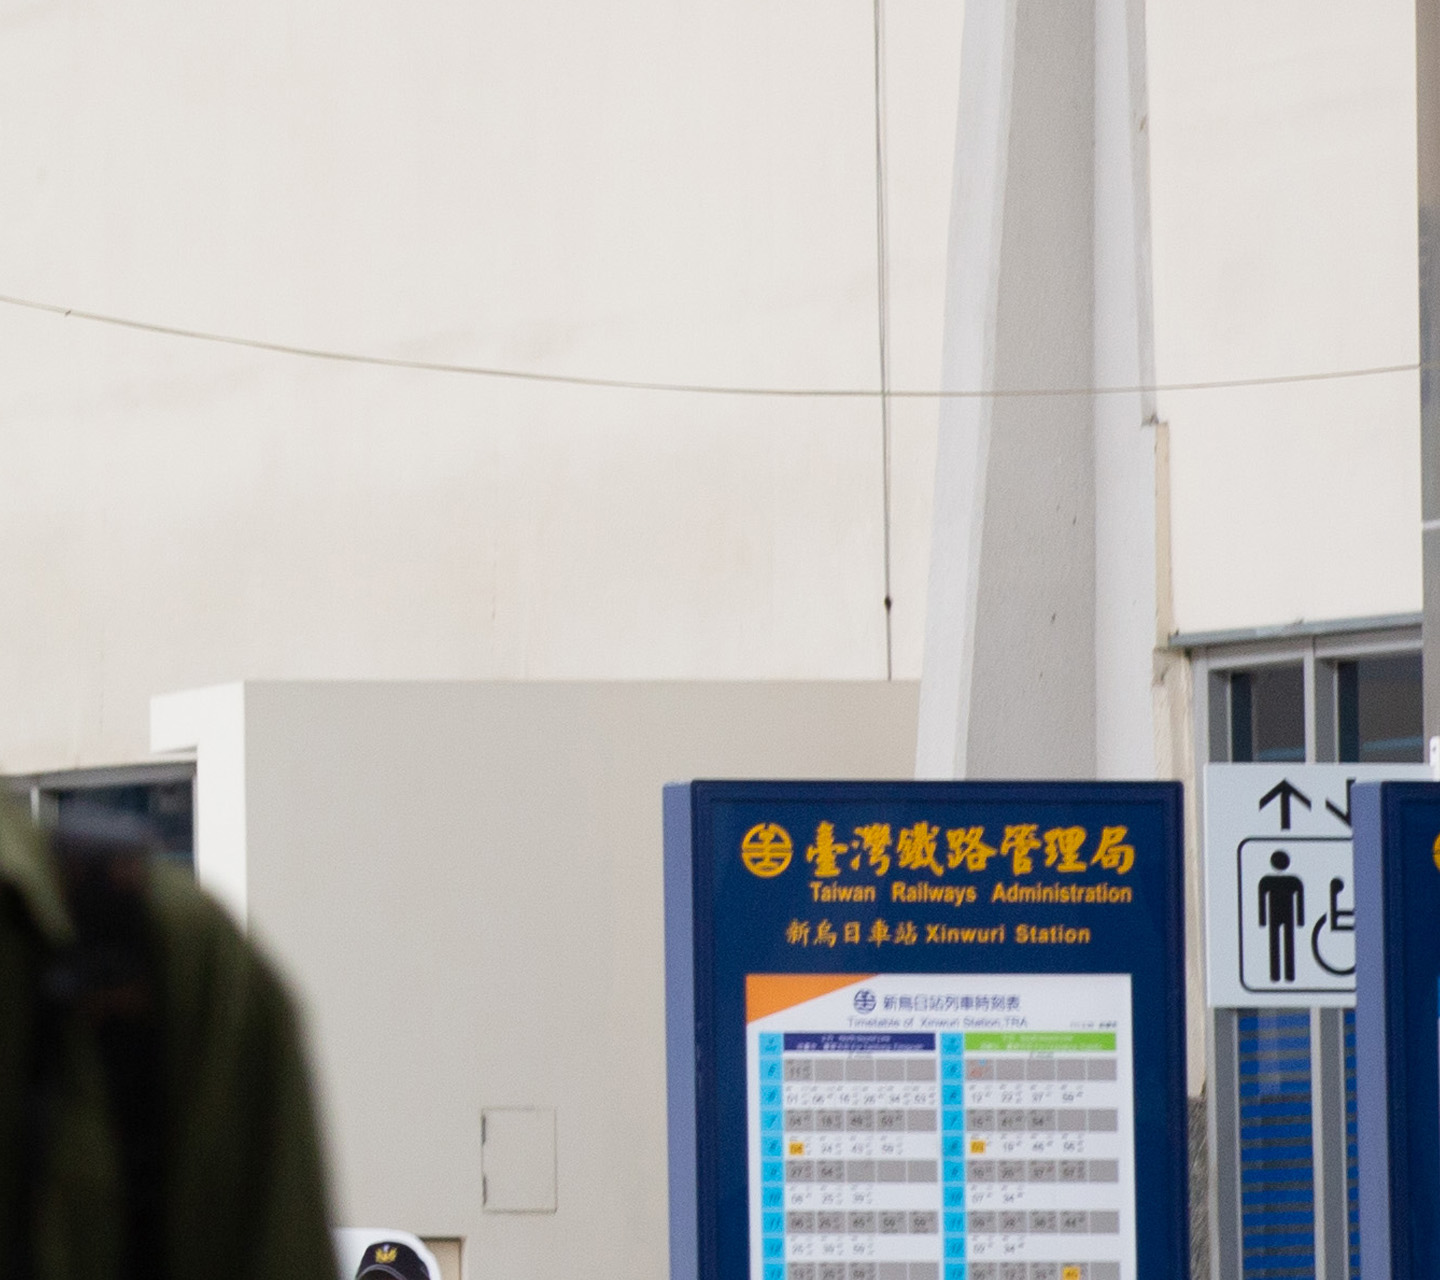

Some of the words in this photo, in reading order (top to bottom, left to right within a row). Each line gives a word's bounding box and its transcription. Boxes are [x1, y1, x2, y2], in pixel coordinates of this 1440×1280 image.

[805, 820, 1136, 875] 臺灣鐵路管理局
[809, 881, 876, 902] Taiwan
[891, 881, 977, 907] Railways
[991, 882, 1133, 903] Administration
[786, 919, 918, 948] 新烏日車站
[925, 924, 1005, 943] Xinwuri
[1015, 924, 1091, 944] Station
